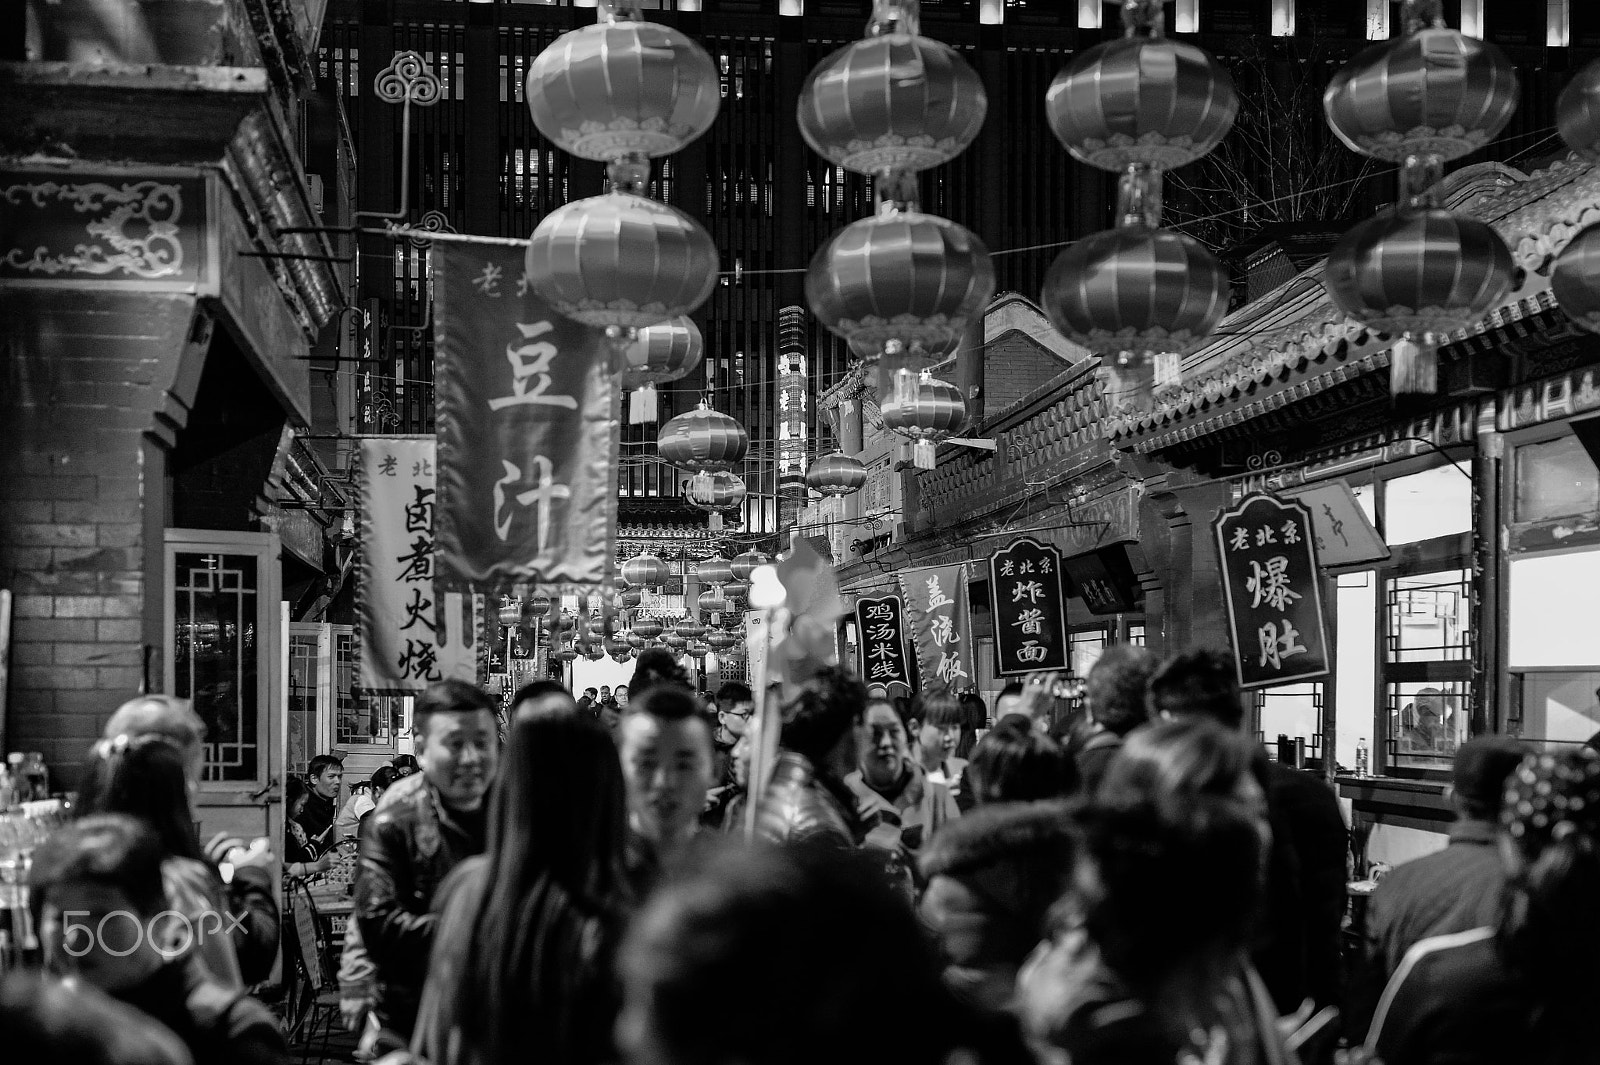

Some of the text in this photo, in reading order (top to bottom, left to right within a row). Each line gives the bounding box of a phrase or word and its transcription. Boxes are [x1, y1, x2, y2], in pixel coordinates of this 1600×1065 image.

[378, 455, 433, 477] 老北
[488, 320, 578, 557] 豆汁
[1000, 557, 1053, 577] 老北京
[1229, 519, 1301, 551] 老北京
[396, 485, 442, 682] 卤煮火烧
[1011, 580, 1048, 663] 炸酱面
[1245, 555, 1308, 670] 爆肚
[866, 603, 900, 679] 鸡汤米线
[926, 575, 967, 683] 盖浇饭
